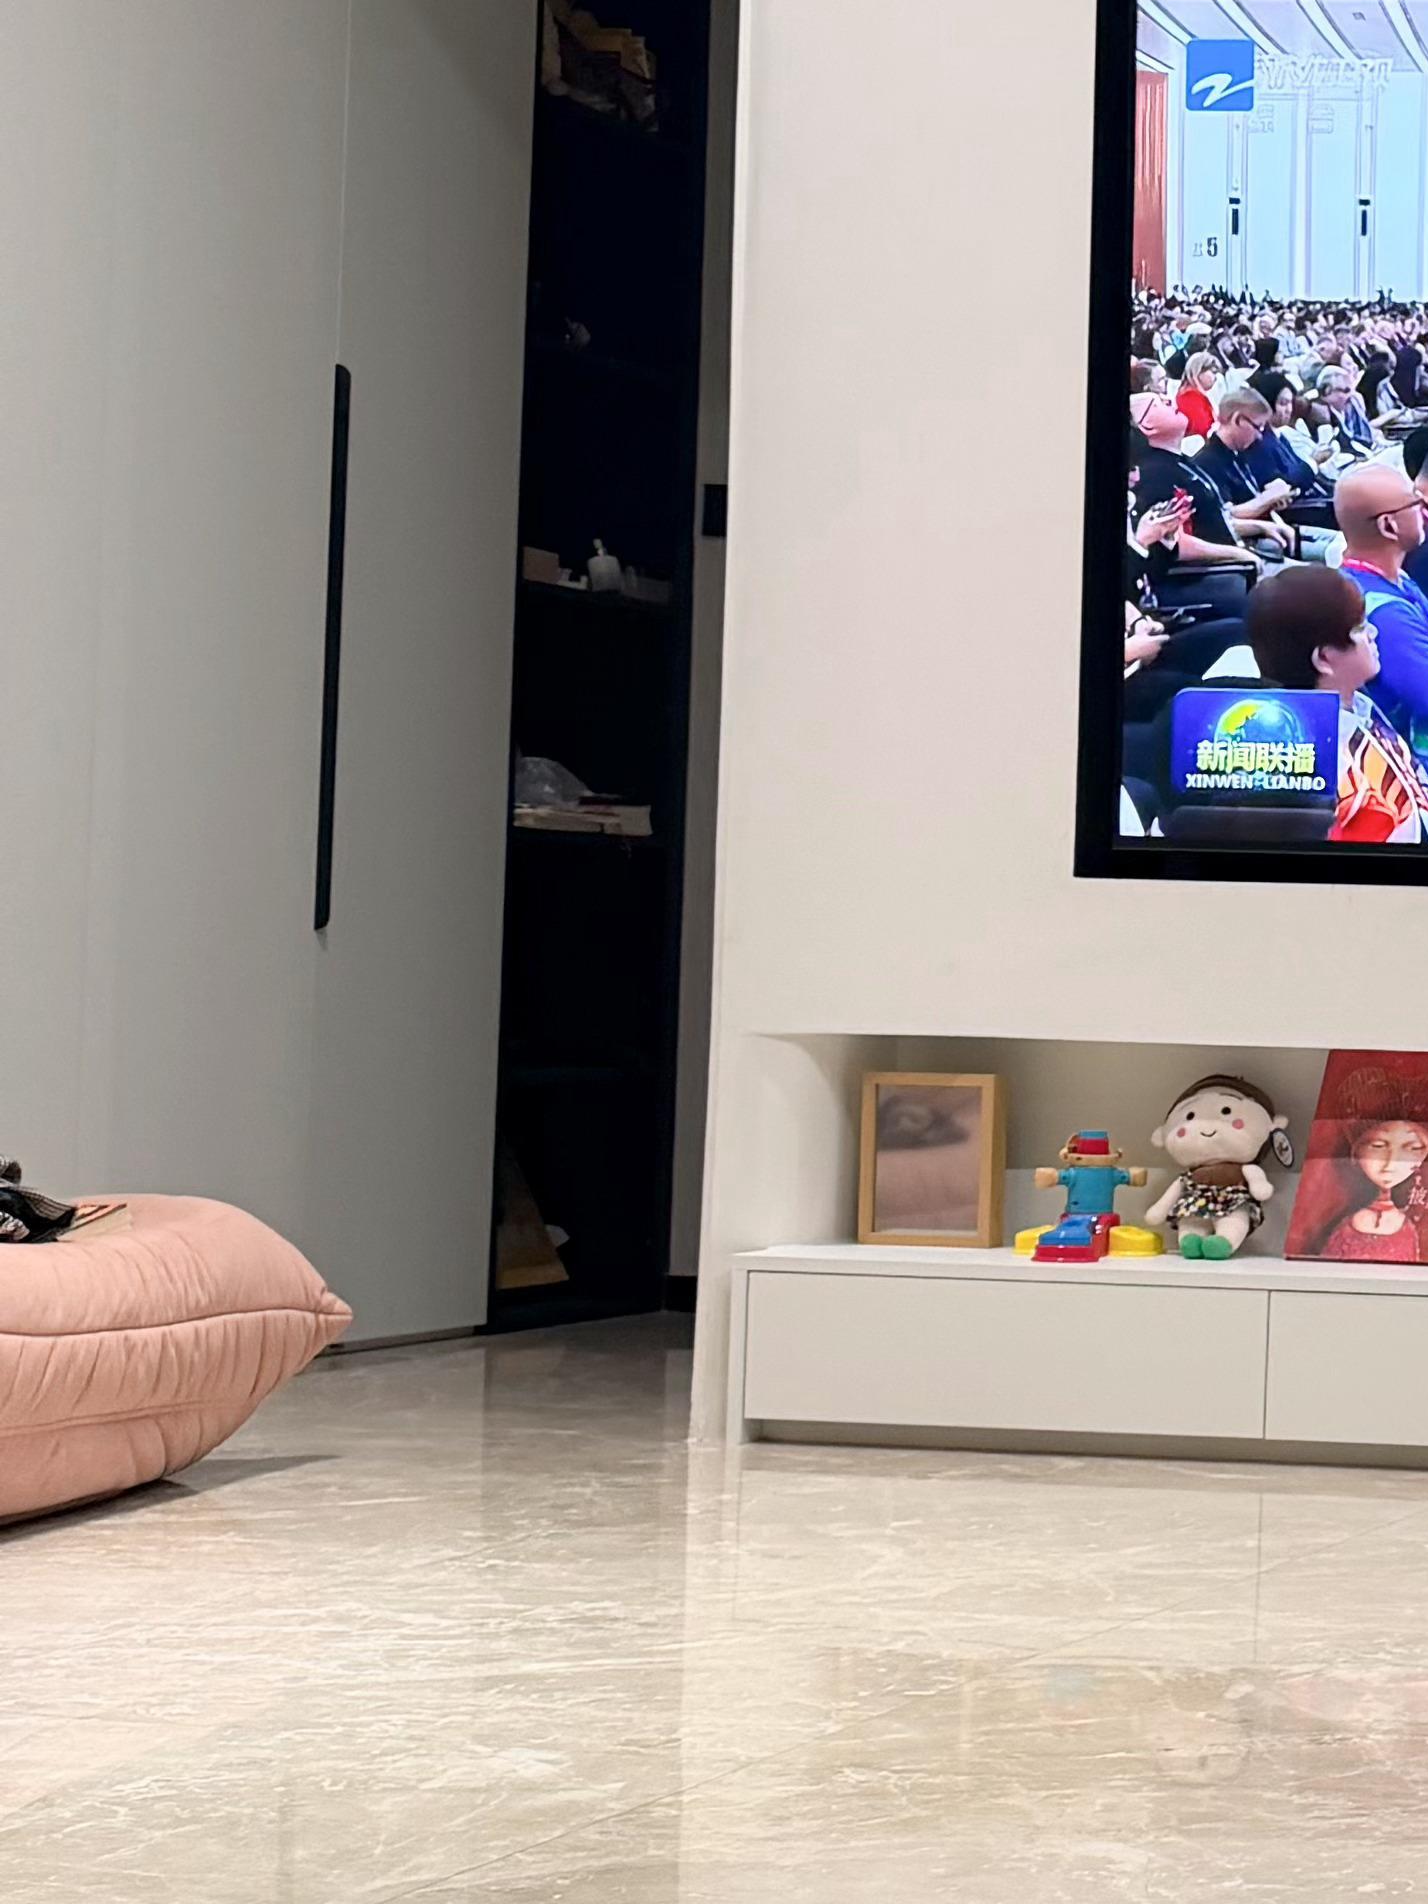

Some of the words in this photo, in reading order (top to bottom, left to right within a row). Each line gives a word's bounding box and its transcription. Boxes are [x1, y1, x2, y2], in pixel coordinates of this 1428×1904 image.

[1206, 236, 1218, 258] 5
[1196, 739, 1316, 774] 新闻联播
[1185, 773, 1253, 790] XINWEN
[1262, 774, 1326, 791] LIANBO
